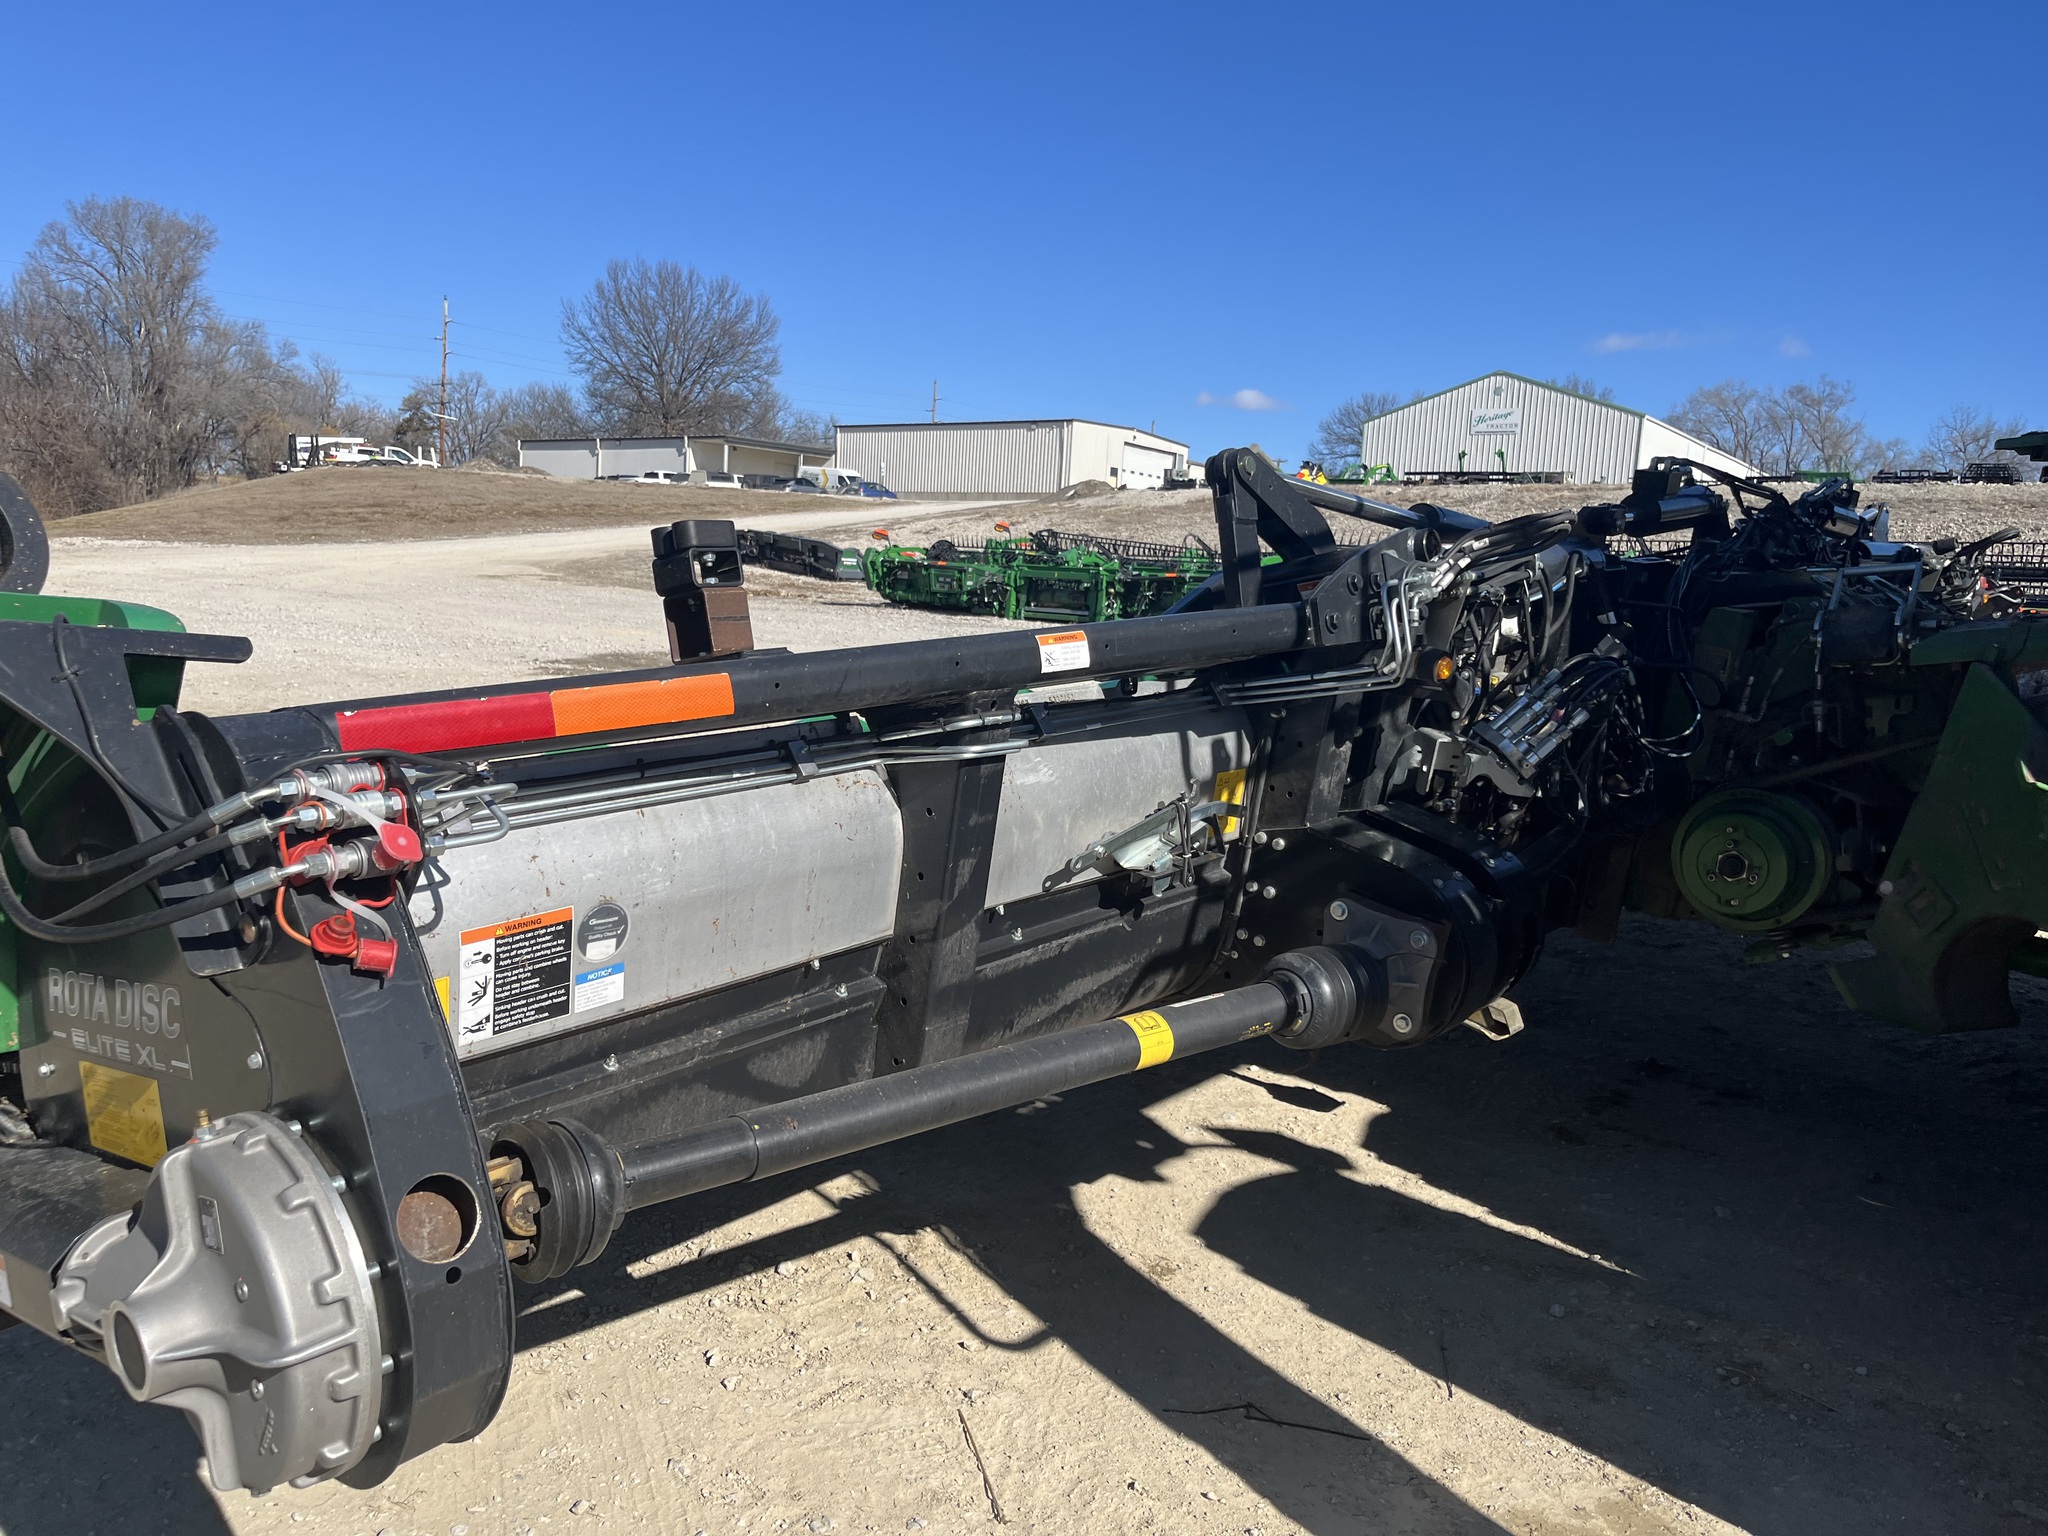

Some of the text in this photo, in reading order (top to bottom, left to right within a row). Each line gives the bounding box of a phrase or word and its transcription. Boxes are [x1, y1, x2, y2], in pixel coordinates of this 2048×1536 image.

[1473, 411, 1514, 427] Heritage
[505, 918, 542, 932] WARNING
[496, 936, 513, 945] Moving
[513, 934, 525, 942] parts
[496, 944, 511, 953] Before
[512, 940, 530, 950] working
[517, 946, 532, 955] engine
[558, 938, 566, 946] key
[499, 959, 512, 967] Apply
[534, 948, 551, 958] parking
[495, 971, 512, 979] Moving
[533, 960, 552, 969] combine
[587, 968, 613, 980] NOTICE
[521, 977, 540, 986] between
[494, 991, 511, 999] header
[494, 1003, 511, 1012] Sinking
[511, 999, 527, 1007] header
[536, 993, 549, 1001] crush
[48, 967, 181, 1039] ROTA DISC
[494, 995, 568, 1020] Before working underneath header
[494, 1017, 511, 1026] engage
[511, 1013, 526, 1021] safety
[500, 1020, 522, 1030] combine's
[70, 1027, 167, 1070] ELITE XL
